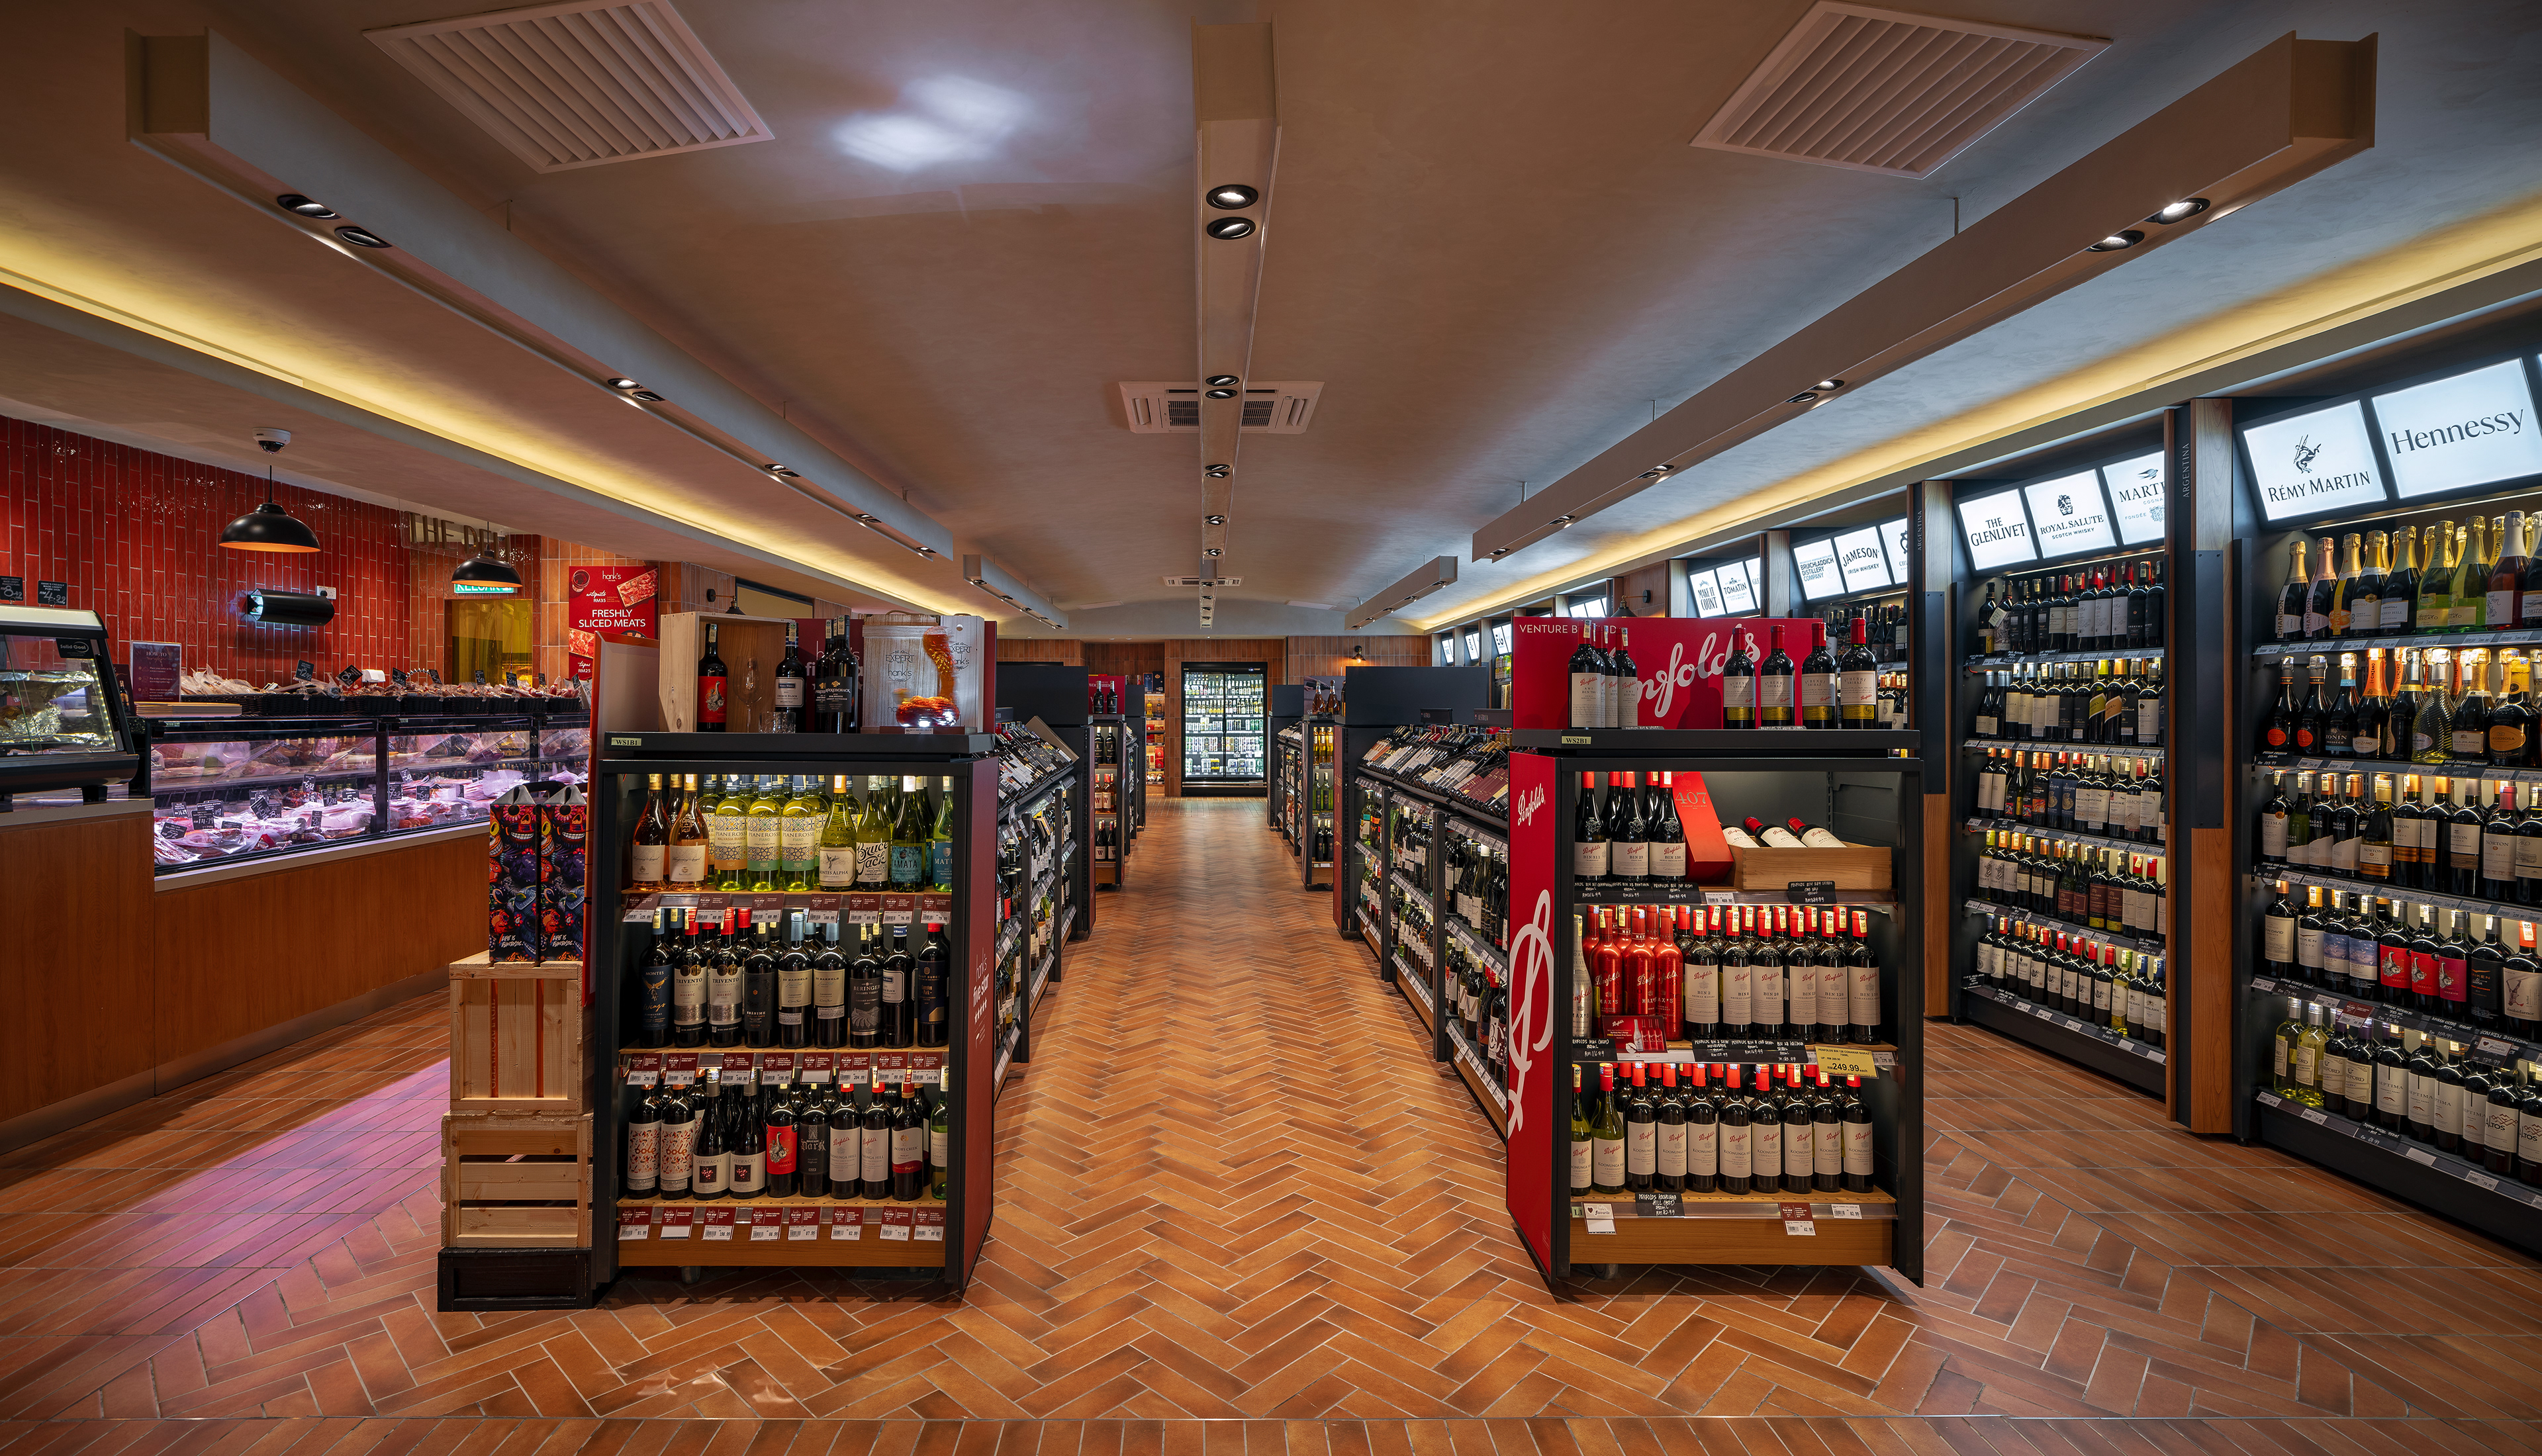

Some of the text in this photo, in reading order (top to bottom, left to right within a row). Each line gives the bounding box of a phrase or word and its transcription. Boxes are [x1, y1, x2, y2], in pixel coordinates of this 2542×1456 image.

[2390, 408, 2524, 454] Hennessy
[2267, 471, 2371, 502] RÉMY MARTIN
[1985, 518, 2003, 529] THE
[2040, 514, 2104, 535] ROYAL SALUTE
[404, 510, 456, 551] THE
[1971, 523, 2026, 547] GLENLIVET
[2073, 527, 2095, 536] WHISKY
[1843, 547, 1879, 567] JAMESON
[1800, 557, 1834, 570] BRUICHLADDICH
[1859, 563, 1879, 572] WHISKEY
[602, 567, 621, 580] hank's
[1802, 567, 1824, 576] DISTILLERY
[1803, 572, 1824, 582] COMPANY
[1698, 588, 1709, 597] MAKE
[1723, 583, 1747, 595] TOMATIN
[1701, 597, 1717, 611] COUNT
[579, 619, 646, 627] SLICED MEATS
[1520, 624, 1568, 633] VENTURE
[886, 655, 914, 663] EXPERT
[888, 664, 912, 676] hank's
[1518, 782, 1545, 826] Penfolds
[1675, 792, 1707, 805] 407
[857, 842, 888, 858] Bruce
[1583, 844, 1601, 854] Penfolds
[1627, 845, 1644, 855] Penfolds
[1664, 845, 1681, 855] Penfolds
[857, 851, 887, 875] Jack
[1595, 972, 1621, 986] Penfolds
[1694, 971, 1713, 980] Penfolds
[1762, 972, 1779, 982] Penfolds
[1824, 972, 1844, 981] Penfolds
[1859, 972, 1877, 982] Penfolds
[643, 1002, 666, 1012] Wings
[1832, 1063, 1859, 1071] 249.99
[2485, 1116, 2506, 1131] ALTOS
[1639, 1129, 1654, 1140] Penfolds
[1669, 1131, 1685, 1142] Penfolds
[1699, 1131, 1715, 1141] Penfolds
[1729, 1133, 1748, 1142] Penfolds
[1764, 1131, 1779, 1142] Penfolds
[1797, 1131, 1812, 1142] Penfolds
[1855, 1130, 1871, 1140] Penfolds
[2519, 1126, 2538, 1142] ALTOS
[1604, 1145, 1621, 1155] Penfolds
